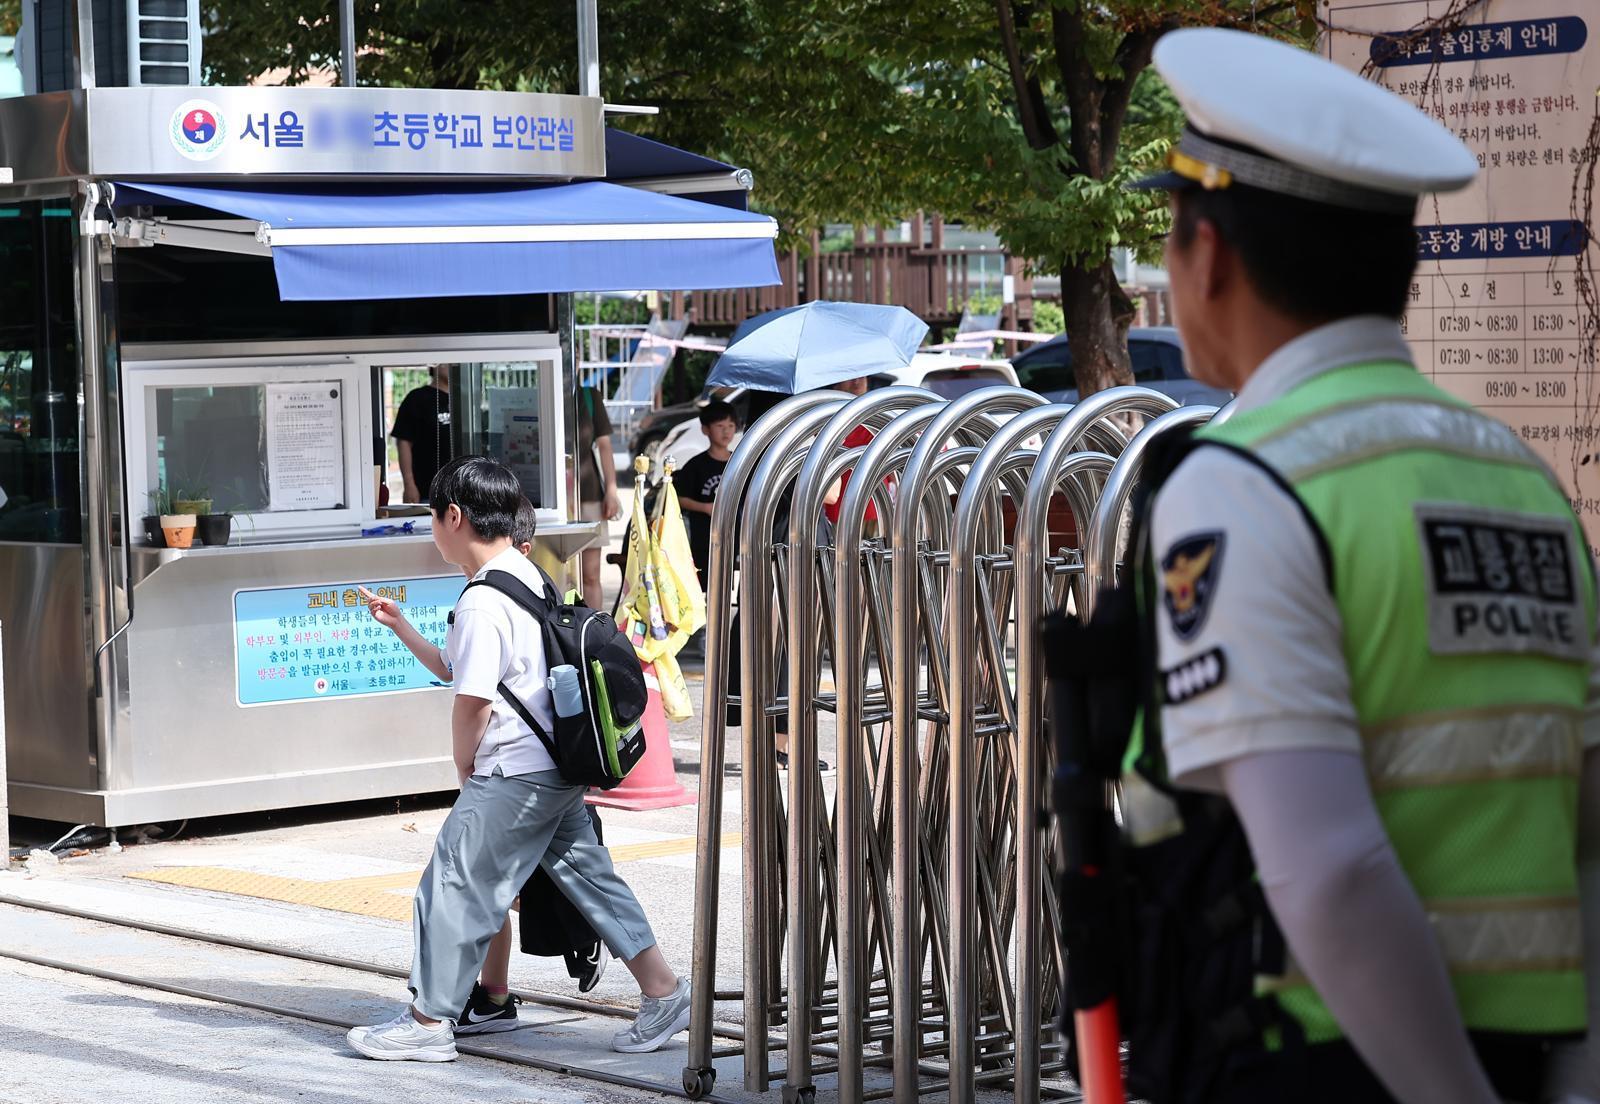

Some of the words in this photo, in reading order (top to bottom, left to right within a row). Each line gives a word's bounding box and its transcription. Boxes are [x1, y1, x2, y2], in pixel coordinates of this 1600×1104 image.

[1440, 26, 1513, 55] 출입통제
[1520, 22, 1558, 48] 안내
[1444, 77, 1465, 93] 경유
[1468, 73, 1516, 91] 바랍니다.
[1449, 100, 1491, 119] 외부차량
[1495, 97, 1526, 116] 통행을
[1531, 94, 1580, 114] 금합니다.
[239, 111, 304, 148] 서울
[491, 115, 575, 152] 보안관실
[1459, 125, 1490, 142] 주시기
[1494, 122, 1542, 141] 바랍니다.
[1491, 151, 1501, 168] 및
[1505, 149, 1539, 166] 차량은
[1542, 147, 1564, 165] 센터
[1471, 227, 1508, 252] 개방
[1514, 225, 1552, 250] 안내
[1439, 315, 1470, 332] 07:30
[1487, 314, 1519, 332] 08:30
[1532, 313, 1564, 331] 16:30
[1440, 348, 1471, 365] 07:30
[1487, 348, 1519, 365] 08:30
[1533, 347, 1564, 364] 13:00
[1486, 381, 1517, 398] 09:00
[1535, 381, 1567, 398] 18:00
[1520, 424, 1560, 441] 학교장의
[1435, 526, 1571, 598] 교통경찰
[307, 590, 339, 609] 교내
[278, 613, 317, 629] 학생들의
[321, 611, 350, 626] 안전과
[410, 604, 437, 619] 위하여
[246, 635, 276, 648] 학부모
[280, 633, 289, 646] 및
[332, 627, 360, 642] 차량의
[364, 626, 383, 639] 학교
[269, 648, 299, 664] 출입이
[303, 648, 313, 660] 꼭
[317, 644, 346, 659] 필요한
[350, 642, 388, 657] 경우에는
[257, 665, 298, 681] 방문증을
[301, 661, 351, 677] 발급받으신
[354, 659, 364, 673] 후
[368, 655, 416, 671] 출입하시기
[331, 679, 350, 691] 서울
